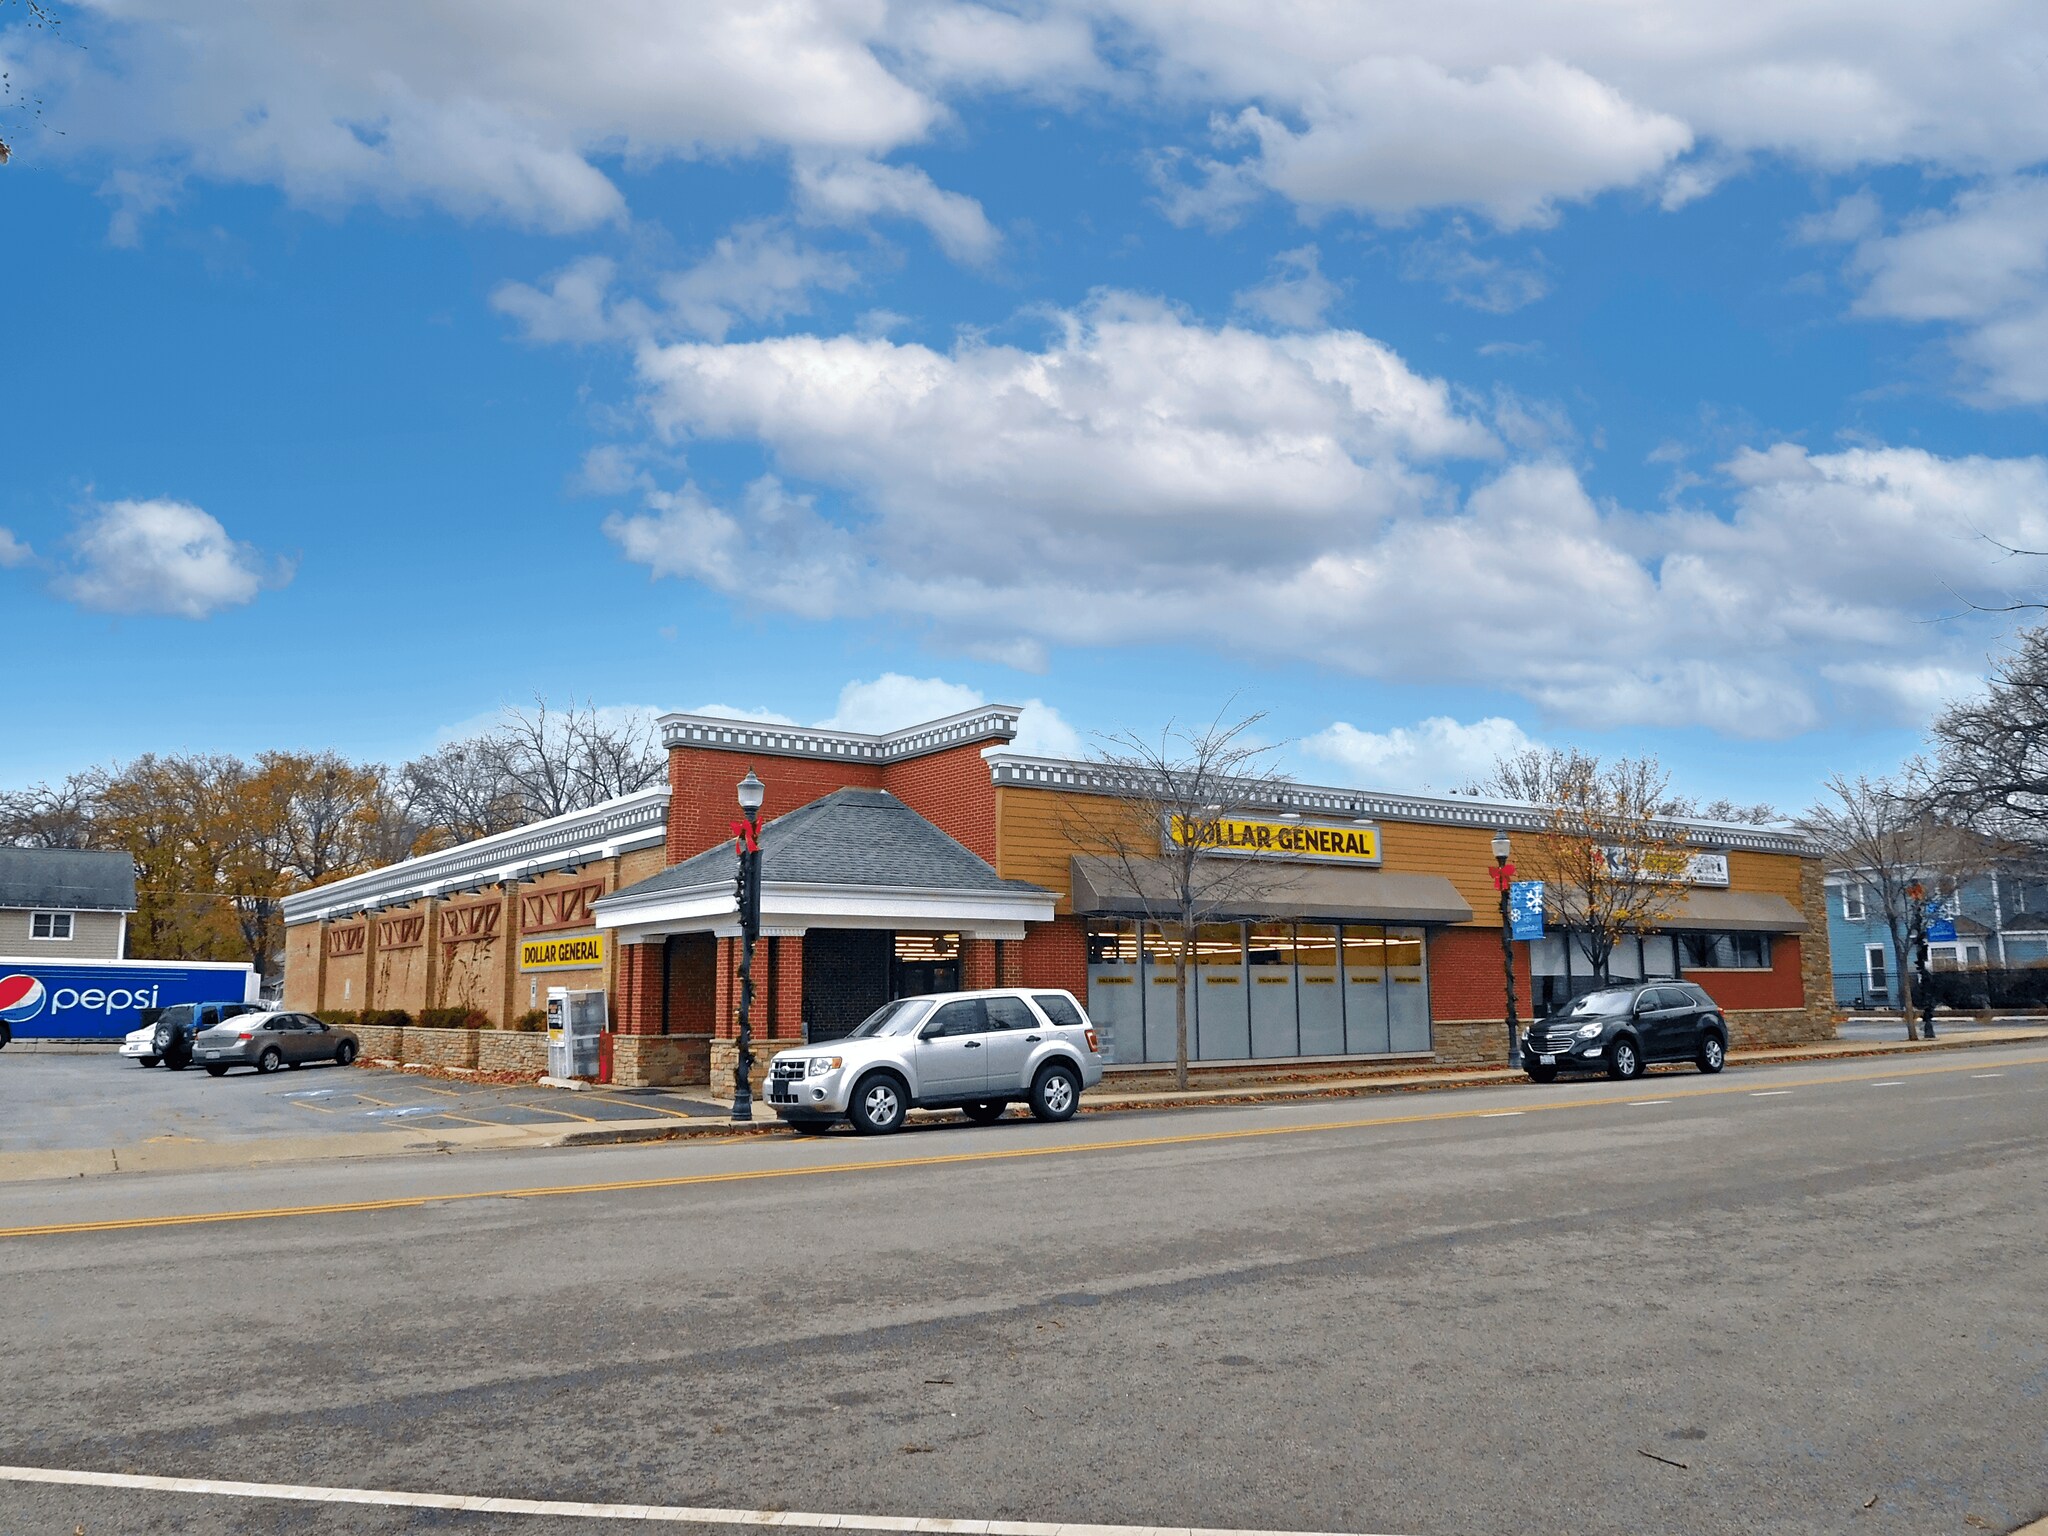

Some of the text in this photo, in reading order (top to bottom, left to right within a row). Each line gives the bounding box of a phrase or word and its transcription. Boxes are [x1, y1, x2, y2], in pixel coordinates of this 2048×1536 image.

[1183, 820, 1370, 855] DOLLAR GENERAL
[524, 940, 599, 964] DOLLAR GENERAL
[51, 984, 159, 1015] pepsi
